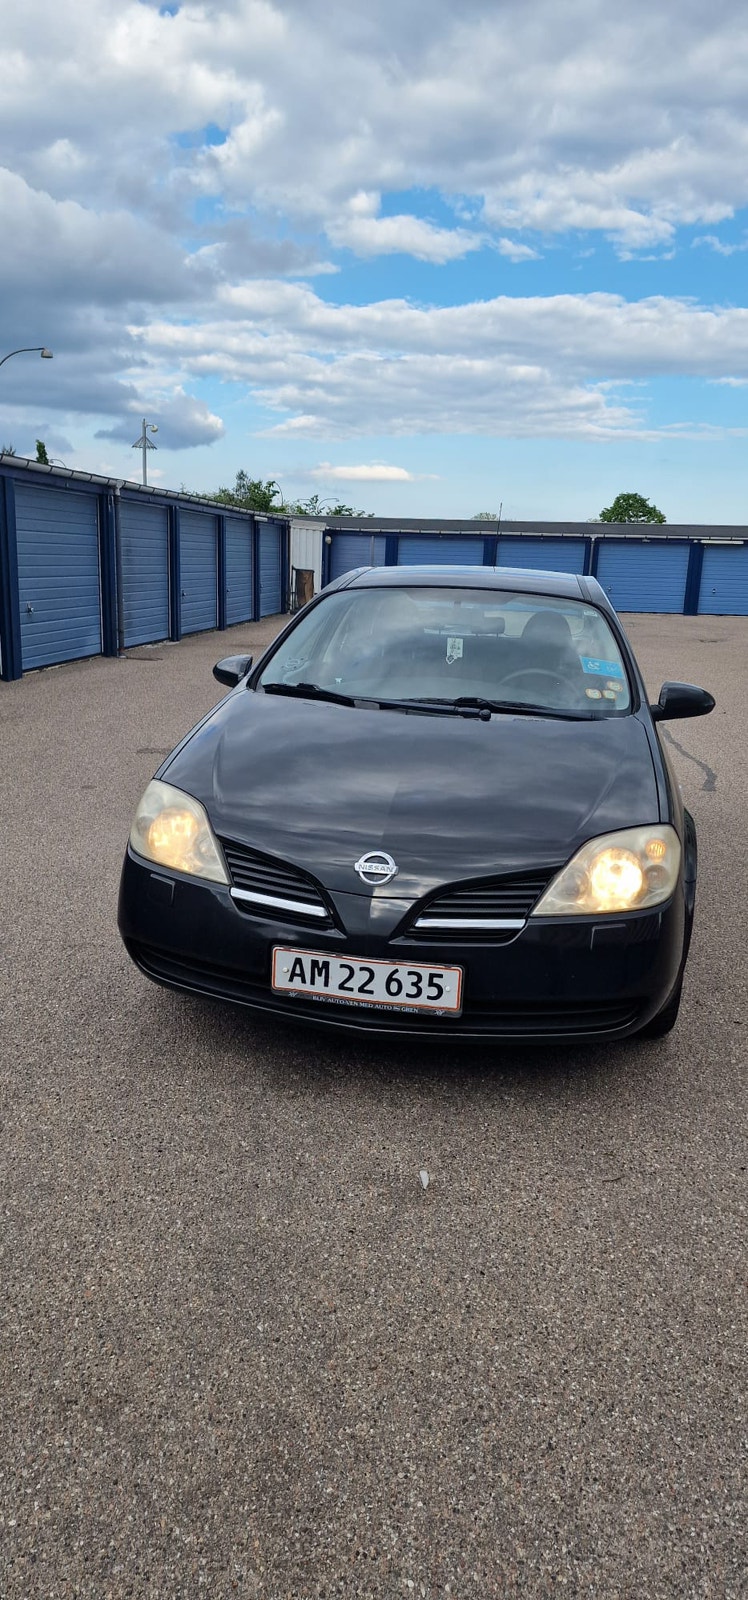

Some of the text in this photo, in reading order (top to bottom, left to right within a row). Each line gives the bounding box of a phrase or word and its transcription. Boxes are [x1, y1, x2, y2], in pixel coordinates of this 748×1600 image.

[358, 863, 394, 872] NISSAN
[287, 956, 444, 1001] AM 22 635
[374, 1003, 393, 1011] AUTO
